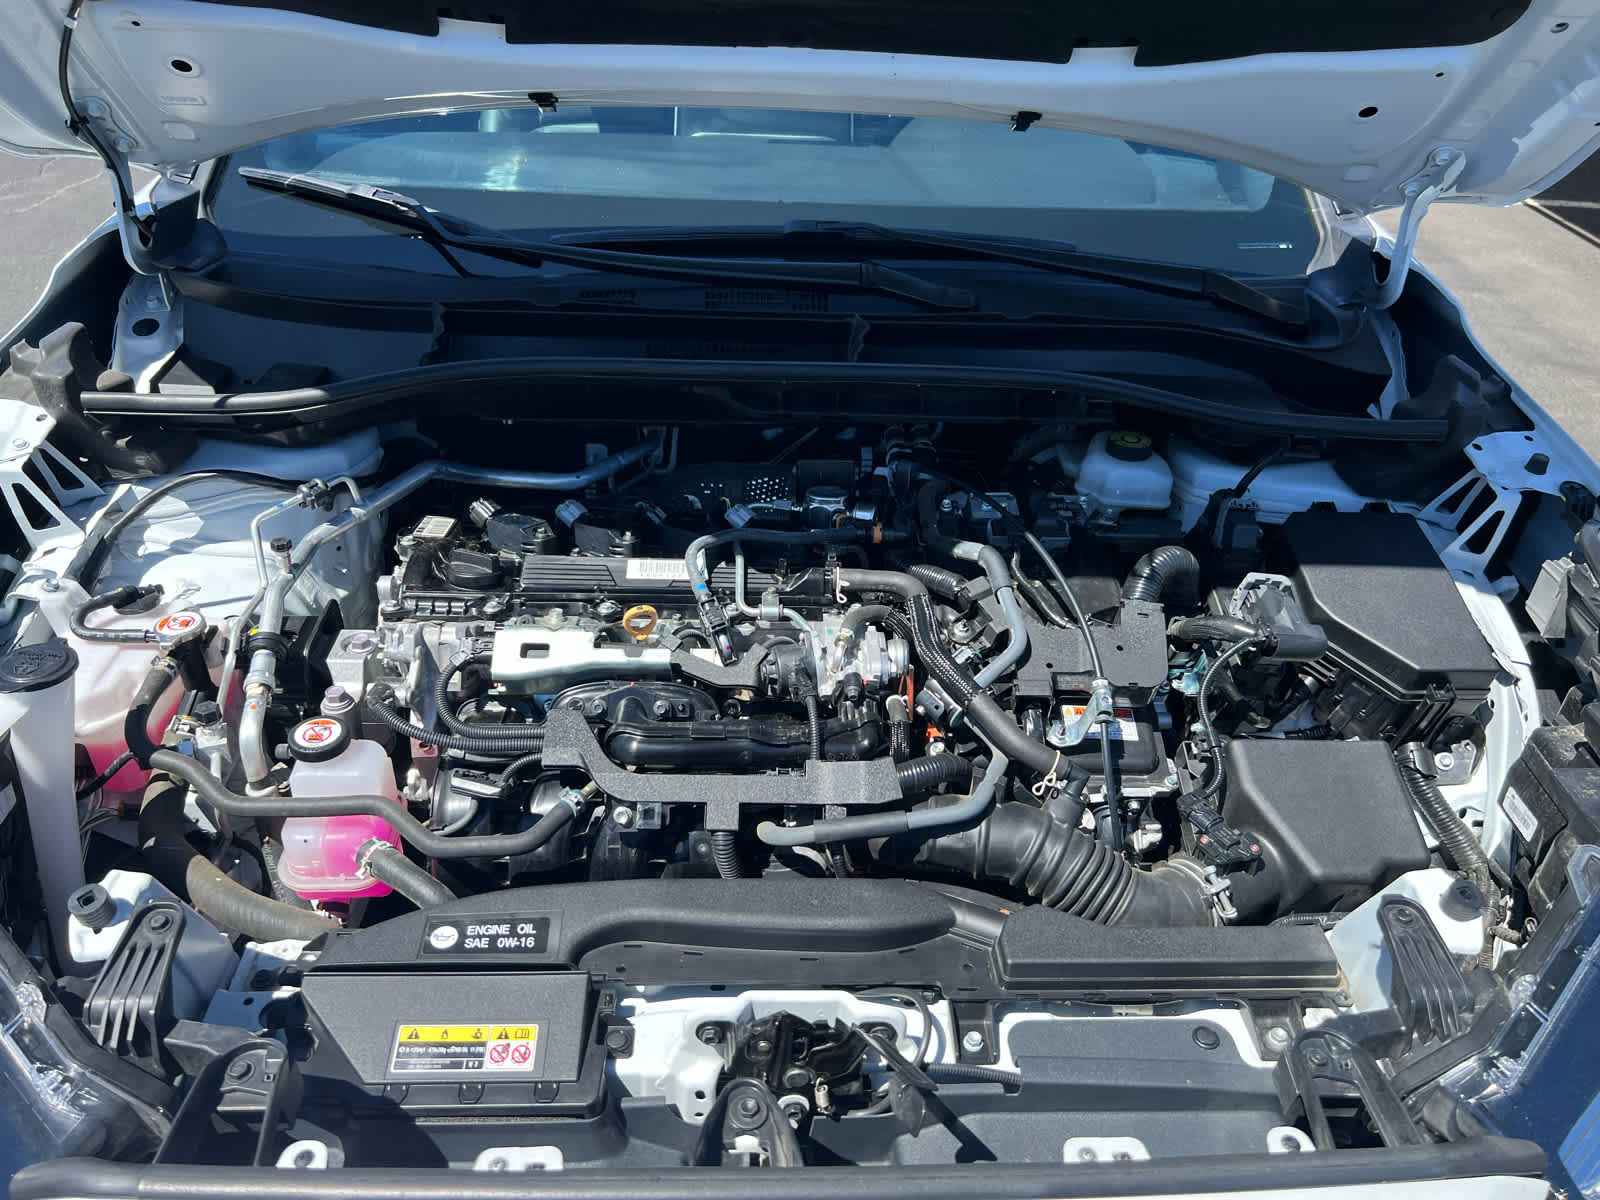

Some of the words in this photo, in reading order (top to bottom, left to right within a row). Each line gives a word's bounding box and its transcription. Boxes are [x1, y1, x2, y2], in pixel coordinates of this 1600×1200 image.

[466, 924, 511, 936] ENGINE
[517, 923, 537, 935] OIL
[464, 937, 490, 948] SAE
[496, 937, 535, 948] 0W-16
